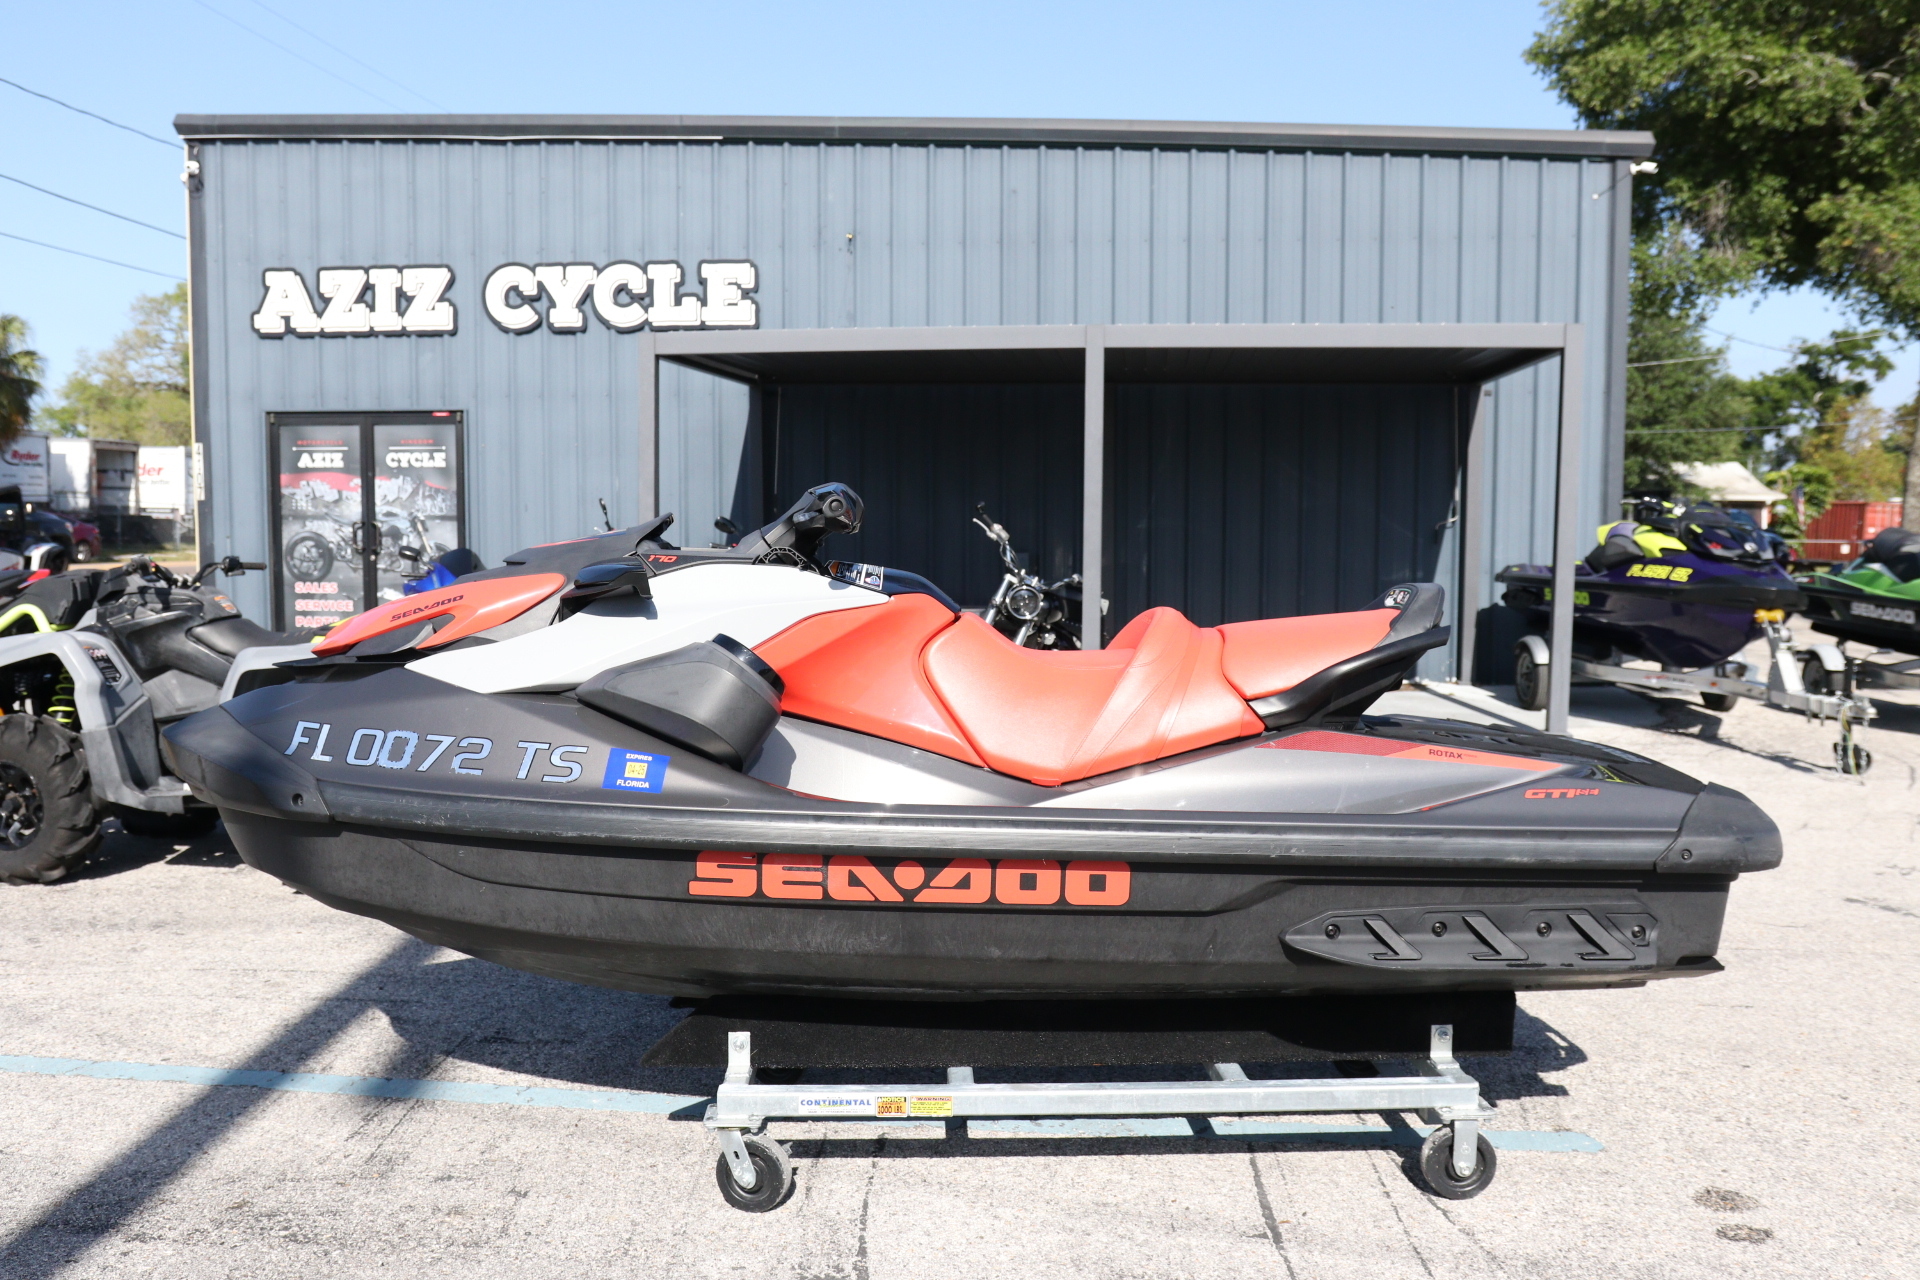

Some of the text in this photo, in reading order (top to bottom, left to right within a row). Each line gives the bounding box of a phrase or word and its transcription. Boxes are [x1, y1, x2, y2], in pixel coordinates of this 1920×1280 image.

[253, 261, 758, 335] AZIZ CYCLE
[11, 449, 41, 462] Ryder
[297, 452, 344, 468] AZIZ
[385, 452, 447, 468] CYCLE
[648, 554, 679, 563] 170
[294, 581, 339, 594] SALES
[294, 599, 354, 612] SERVICE
[283, 719, 589, 784] FL 0072 TS
[625, 753, 653, 761] EXPIRES
[1429, 748, 1463, 760] ROTAX
[616, 778, 650, 789] FLORIDA
